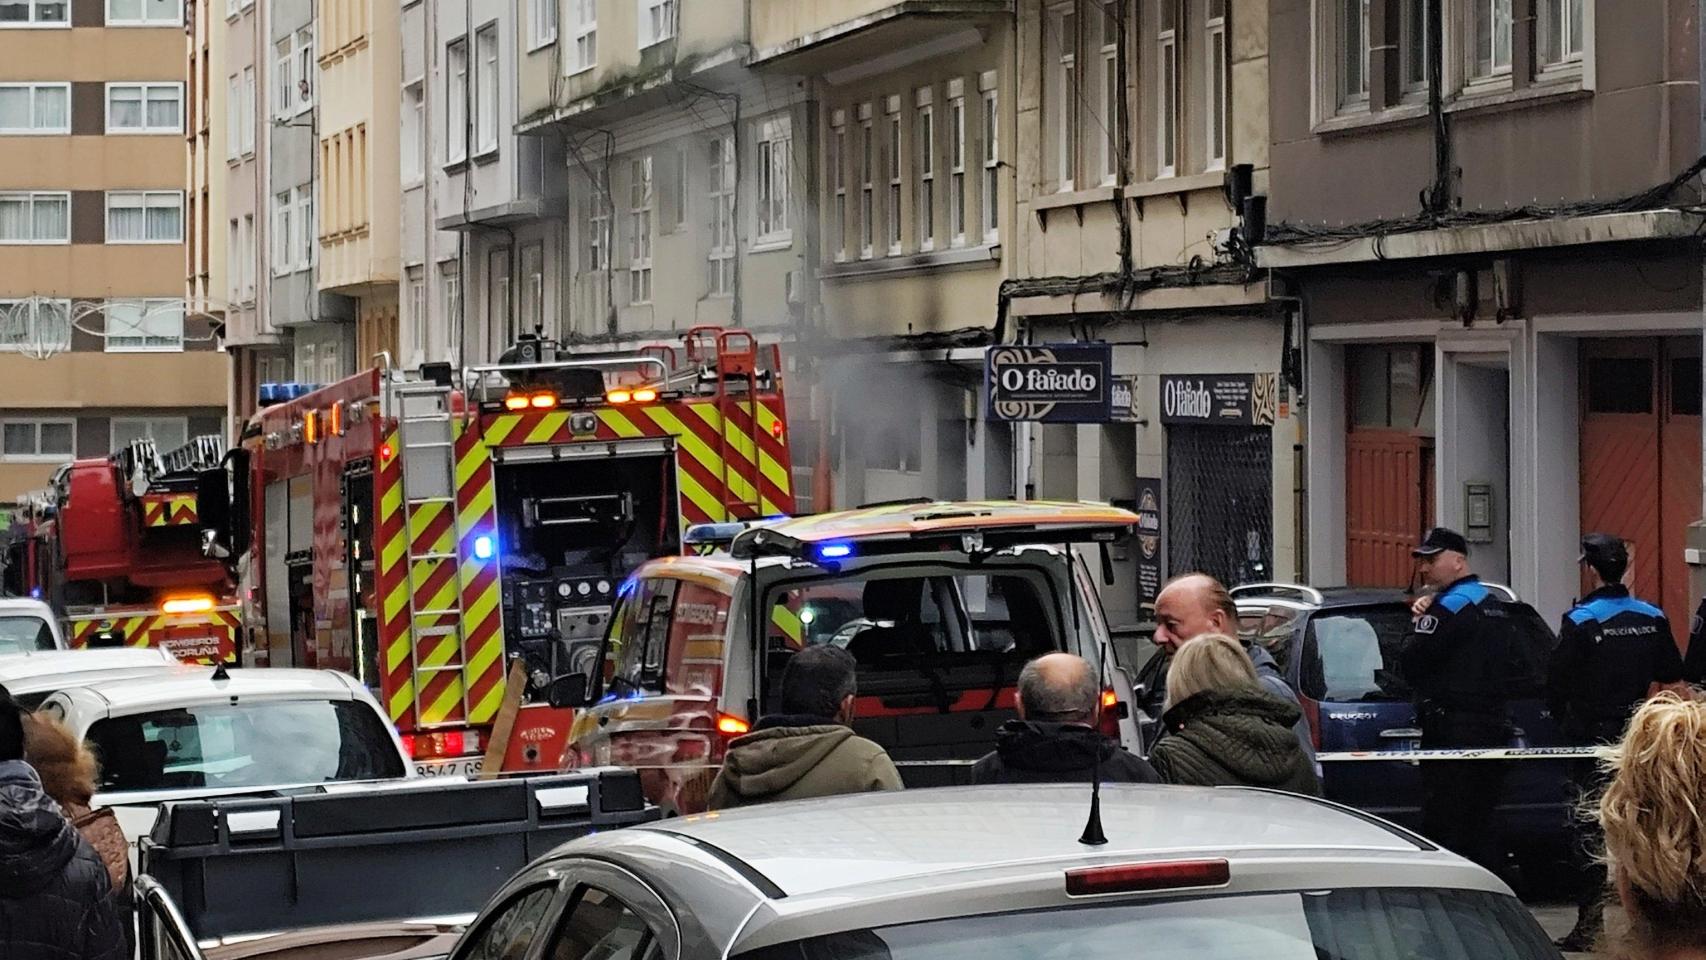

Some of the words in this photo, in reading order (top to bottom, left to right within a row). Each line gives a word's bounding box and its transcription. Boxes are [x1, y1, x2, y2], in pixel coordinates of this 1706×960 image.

[1002, 368, 1024, 391] O
[1026, 368, 1097, 391] faiado
[1165, 380, 1175, 417] O
[1176, 380, 1211, 418] faiado
[171, 645, 219, 657] CORUÑA
